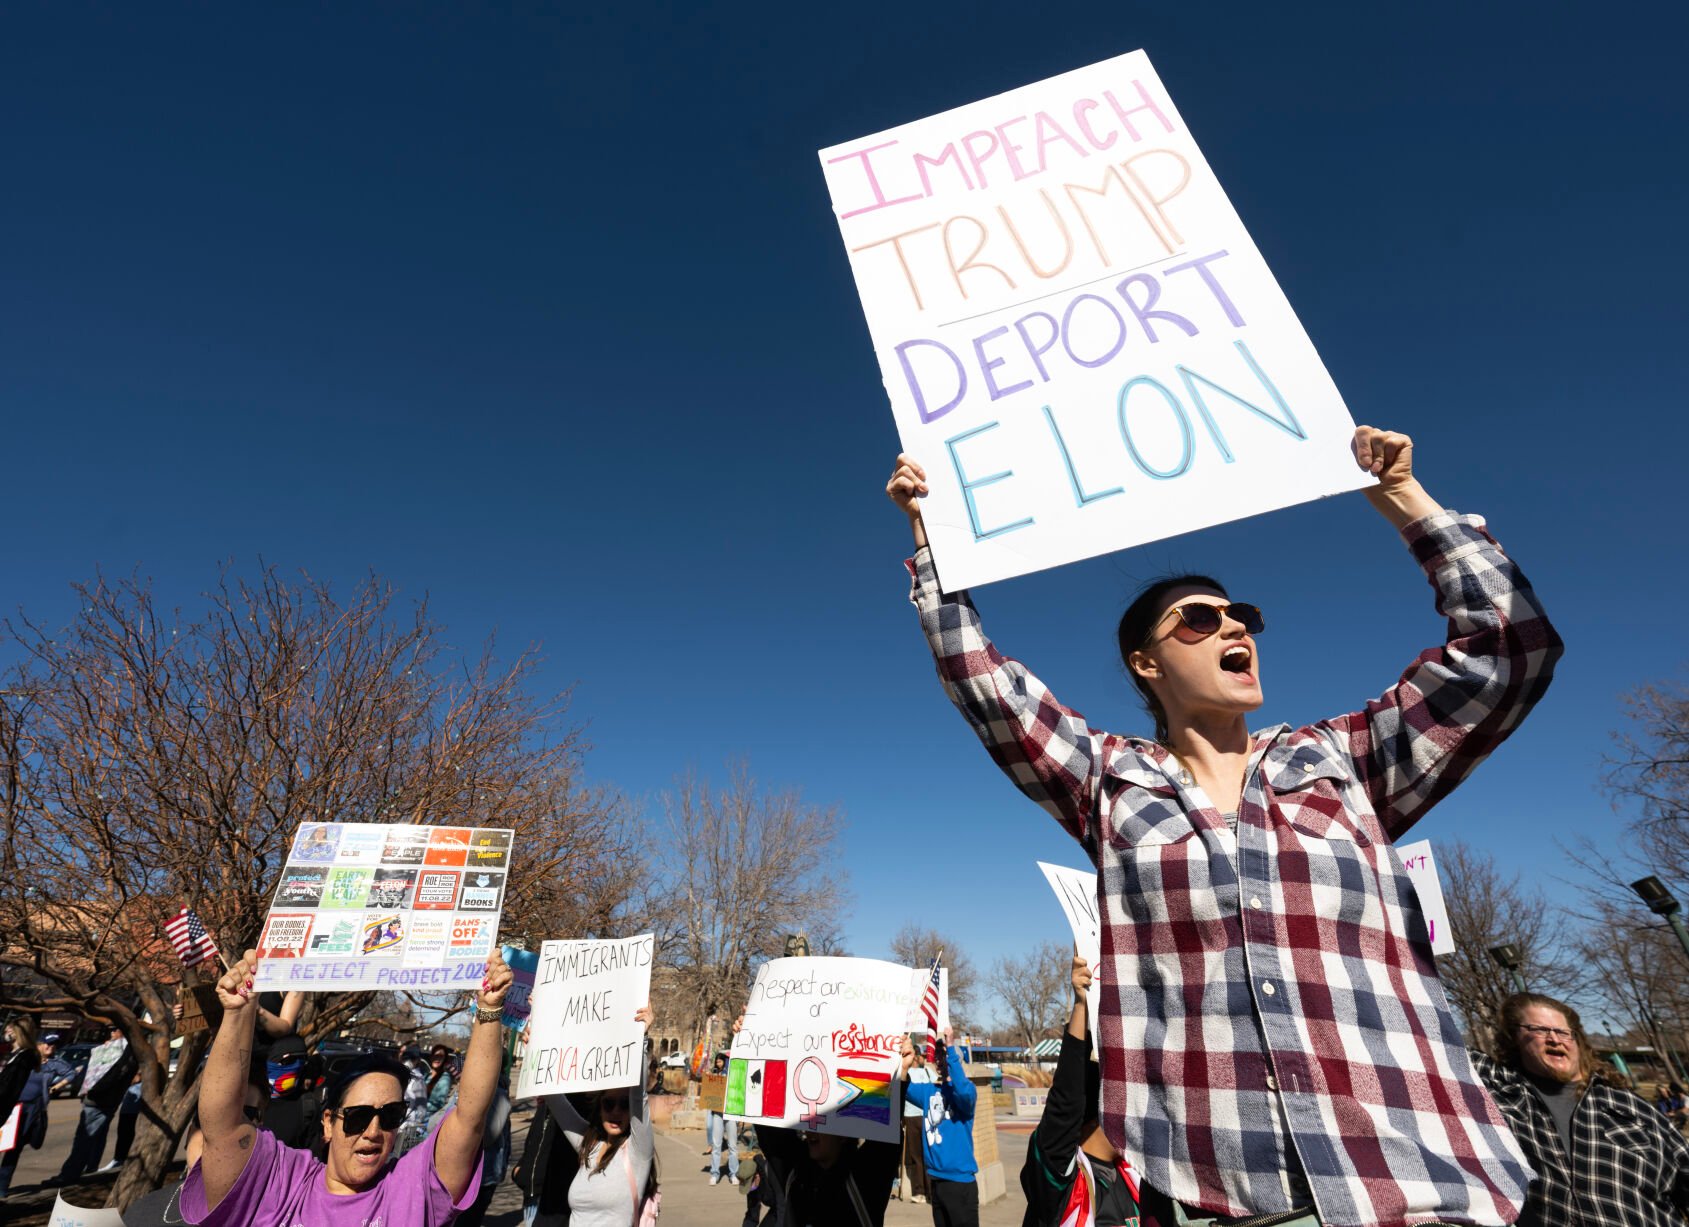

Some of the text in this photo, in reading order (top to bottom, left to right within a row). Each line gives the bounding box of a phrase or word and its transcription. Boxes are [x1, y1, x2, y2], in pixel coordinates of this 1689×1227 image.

[828, 79, 1175, 219] IMPEACH
[852, 148, 1192, 311] TRUMP
[894, 249, 1247, 424] DEPORT
[945, 339, 1308, 542] ELON
[464, 899, 494, 907] BOOKS
[454, 919, 481, 927] BANS
[449, 947, 489, 957] BODIES
[540, 938, 653, 985] IMMIGRANTS
[256, 963, 276, 981] I
[290, 961, 370, 980] REJECT
[376, 967, 452, 986] PROJECT
[820, 981, 846, 1000] our
[562, 990, 613, 1027] MAKE
[809, 1001, 828, 1018] or
[803, 1034, 830, 1052] our
[581, 1042, 636, 1082] GREAT
